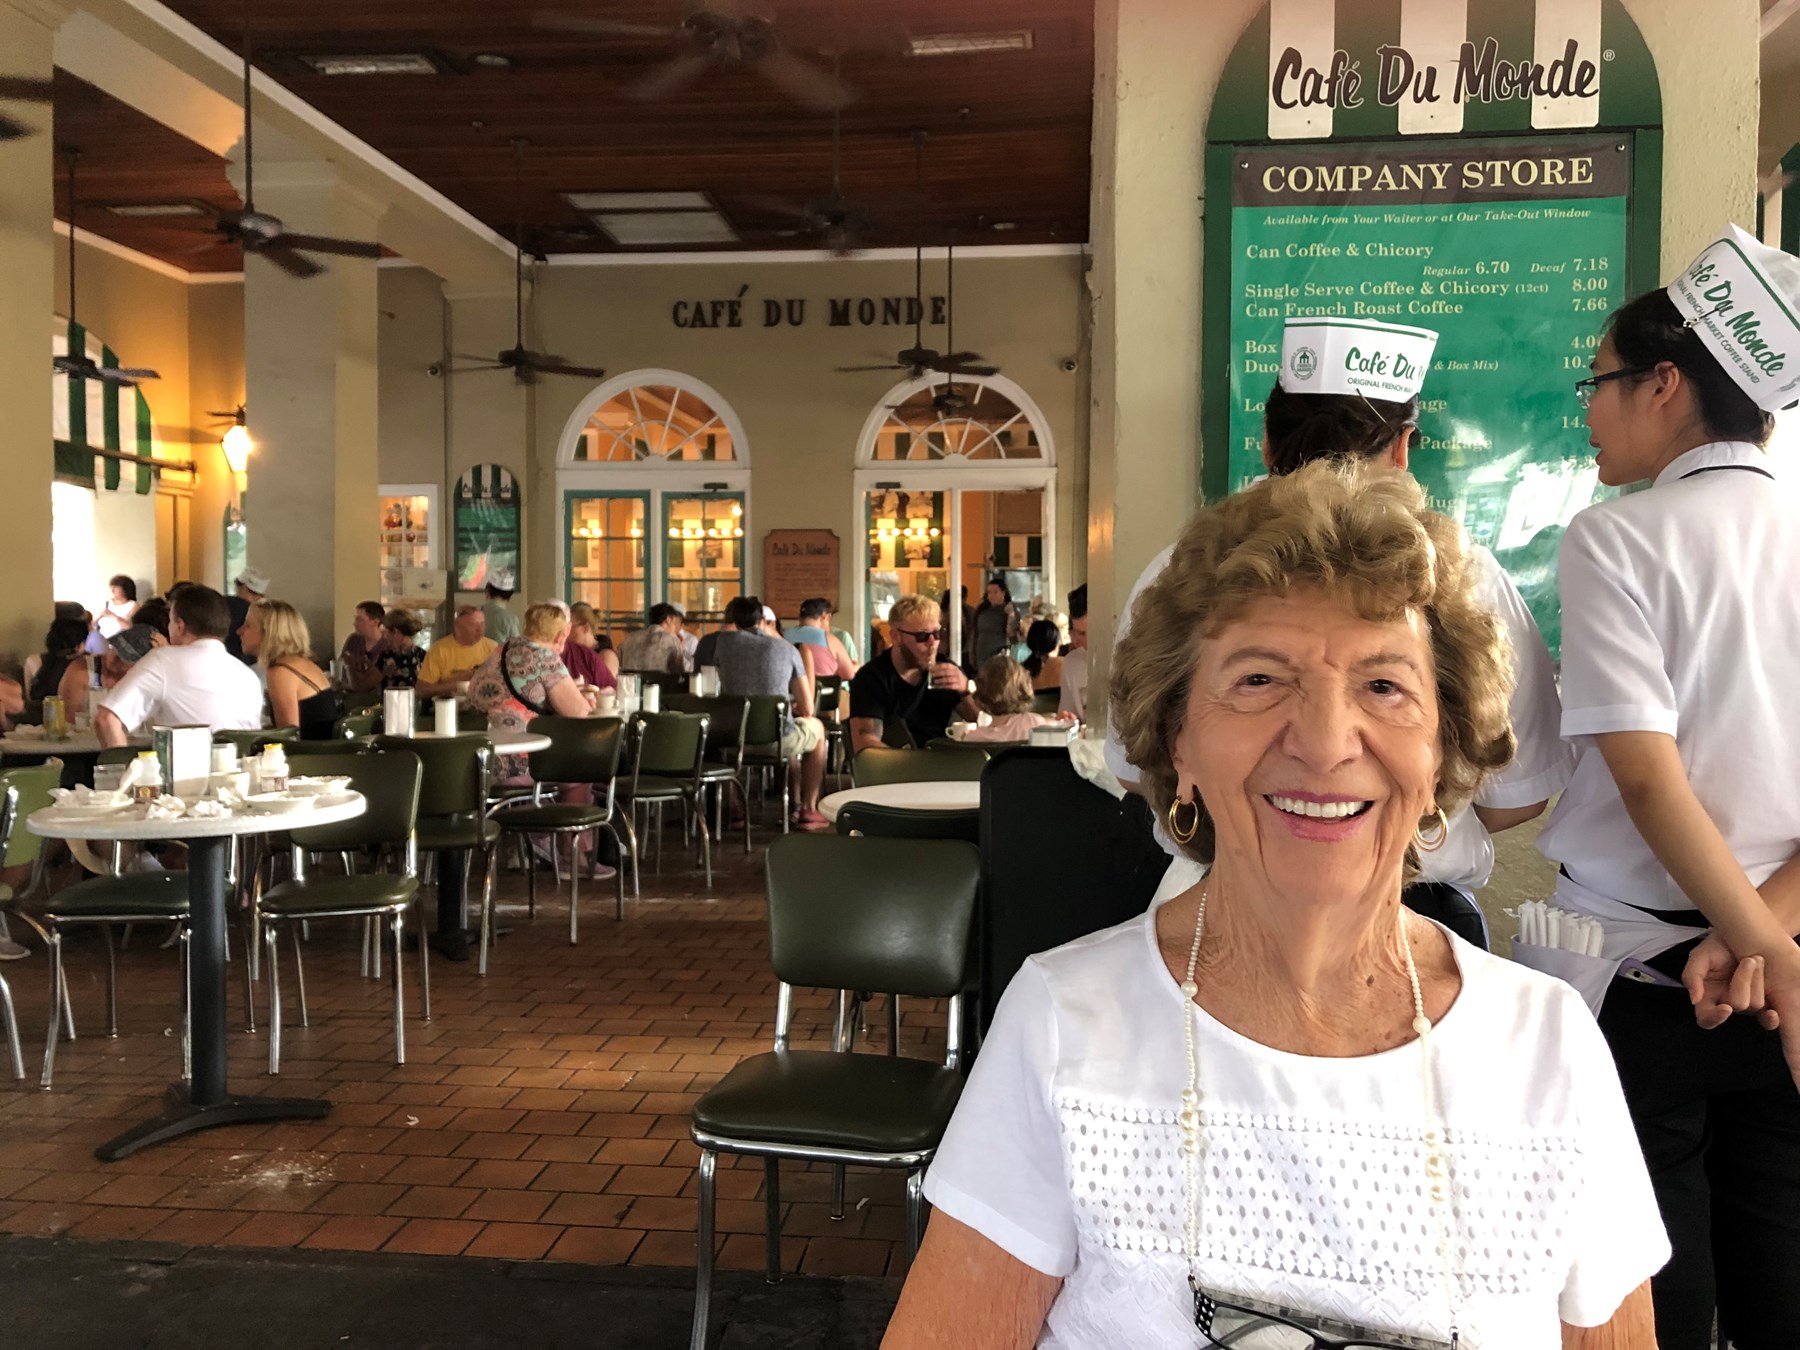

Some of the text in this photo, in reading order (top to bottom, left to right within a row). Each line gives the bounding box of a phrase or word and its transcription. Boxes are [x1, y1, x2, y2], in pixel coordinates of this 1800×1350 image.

[1272, 37, 1600, 111] Café Du Monde
[1262, 157, 1594, 193] COMPANY STORE
[1264, 215, 1318, 225] Available
[1322, 214, 1348, 225] from
[1352, 214, 1380, 224] Your
[1383, 213, 1421, 223] Waiter
[1441, 213, 1453, 222] at
[1456, 211, 1480, 221] Our
[1484, 210, 1539, 221] Take-Out
[1544, 208, 1591, 219] Window
[1246, 242, 1434, 259] Can Coffee & Chicory
[1423, 257, 1608, 277] Regular 6.70 Decaf 7.18
[1245, 278, 1607, 299] Single Serve Coffee & Chicory (12ct) 8.00
[672, 284, 947, 328] CAFÉ DU MONDE
[1246, 298, 1607, 317] Can French Roast Coffee 7.66
[1245, 340, 1277, 353] Box
[1725, 309, 1786, 378] Monde
[1345, 346, 1390, 375] Café
[1392, 353, 1416, 380] Du
[1448, 360, 1469, 370] Box
[1473, 360, 1498, 371] Mix)
[1720, 340, 1743, 364] COFFEE
[1739, 361, 1760, 384] STAND
[1347, 377, 1380, 388] ORIGINAL
